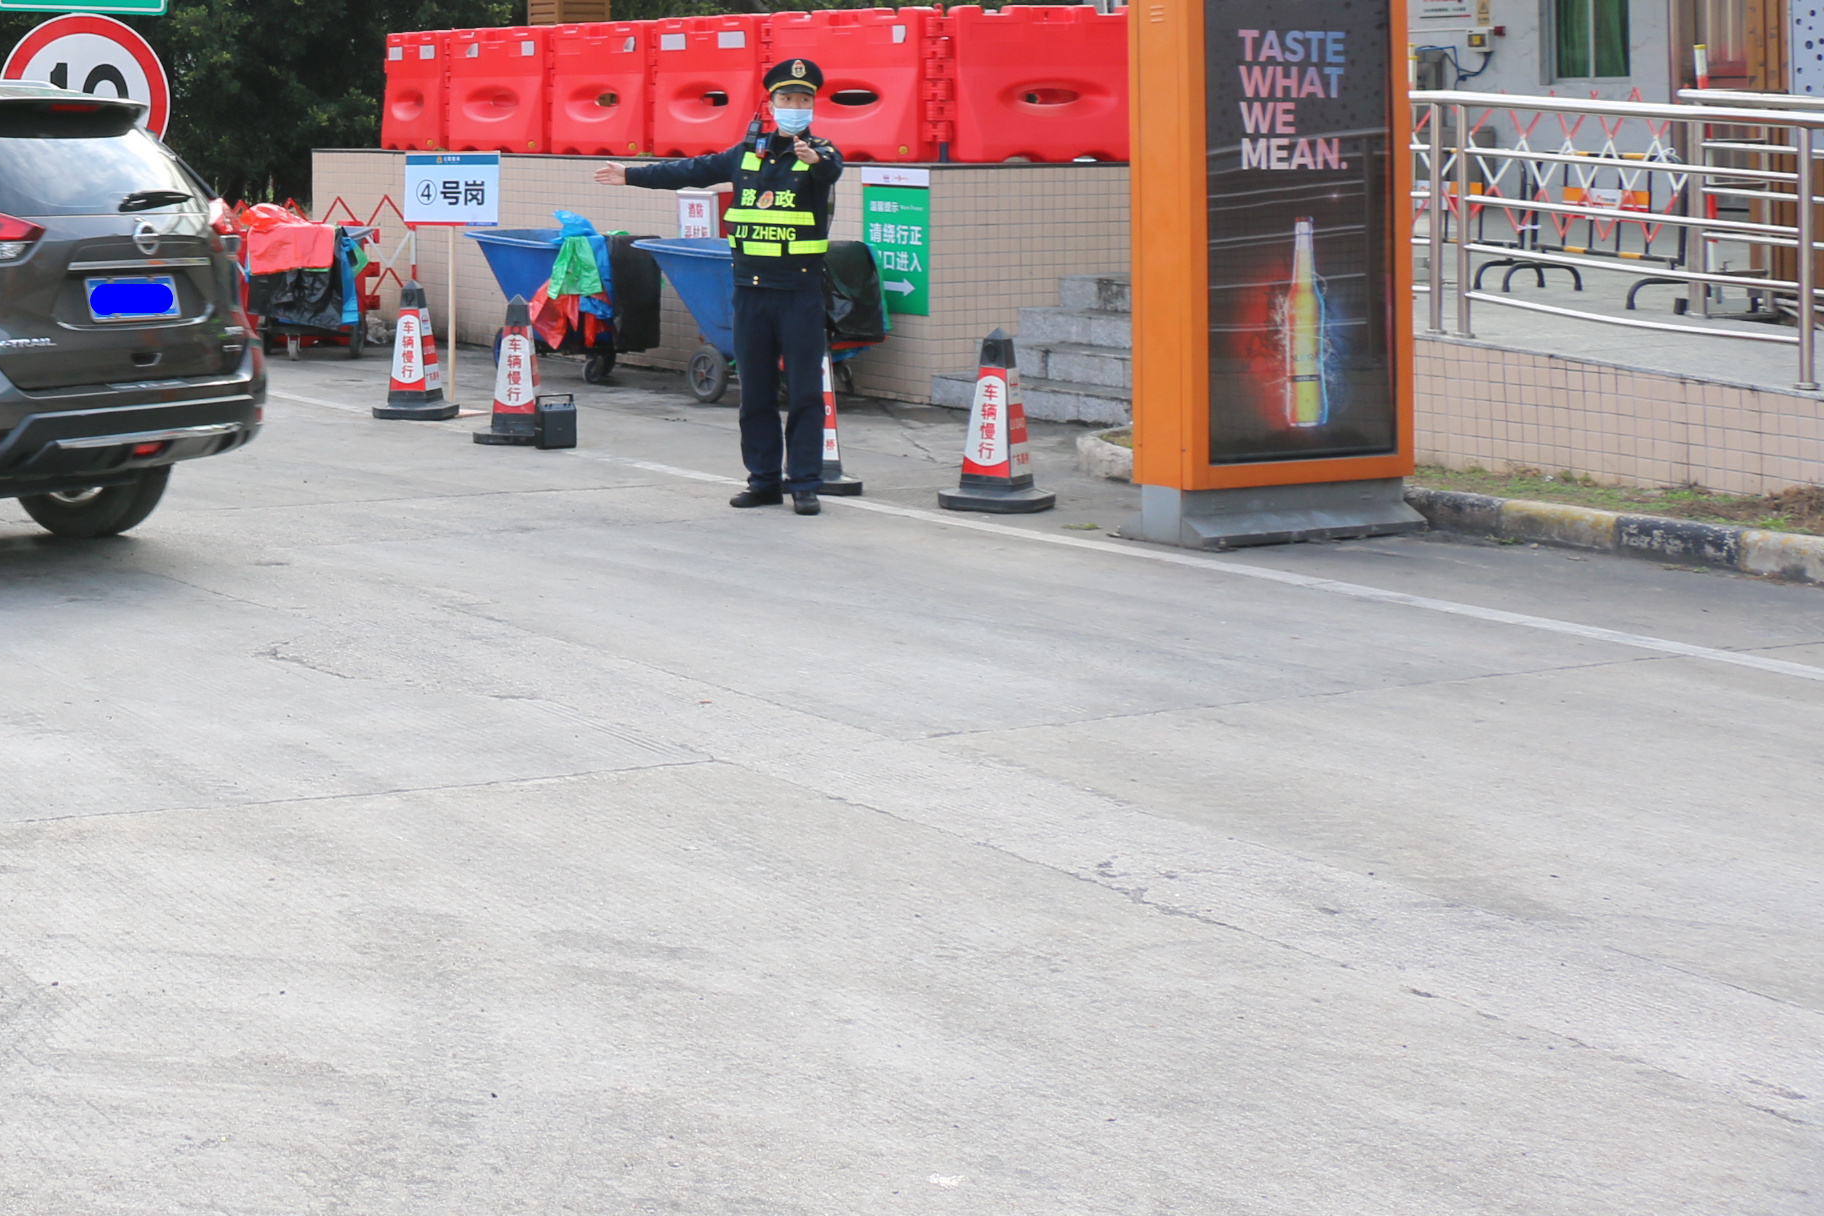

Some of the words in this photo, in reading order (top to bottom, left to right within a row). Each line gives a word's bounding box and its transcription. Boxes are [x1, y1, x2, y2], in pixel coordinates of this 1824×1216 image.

[1238, 29, 1346, 63] TASTE
[1238, 65, 1345, 98] WHAT
[1239, 101, 1296, 134] WE
[1241, 137, 1348, 170] MEAN.
[735, 225, 749, 239] LU
[752, 226, 796, 241] ZHENG
[869, 222, 923, 246] 请绕行正
[877, 249, 923, 272] 口进入
[401, 320, 414, 379] 车辆慢行
[507, 337, 523, 402] 车辆慢行
[978, 383, 999, 460] 车辆慢行
